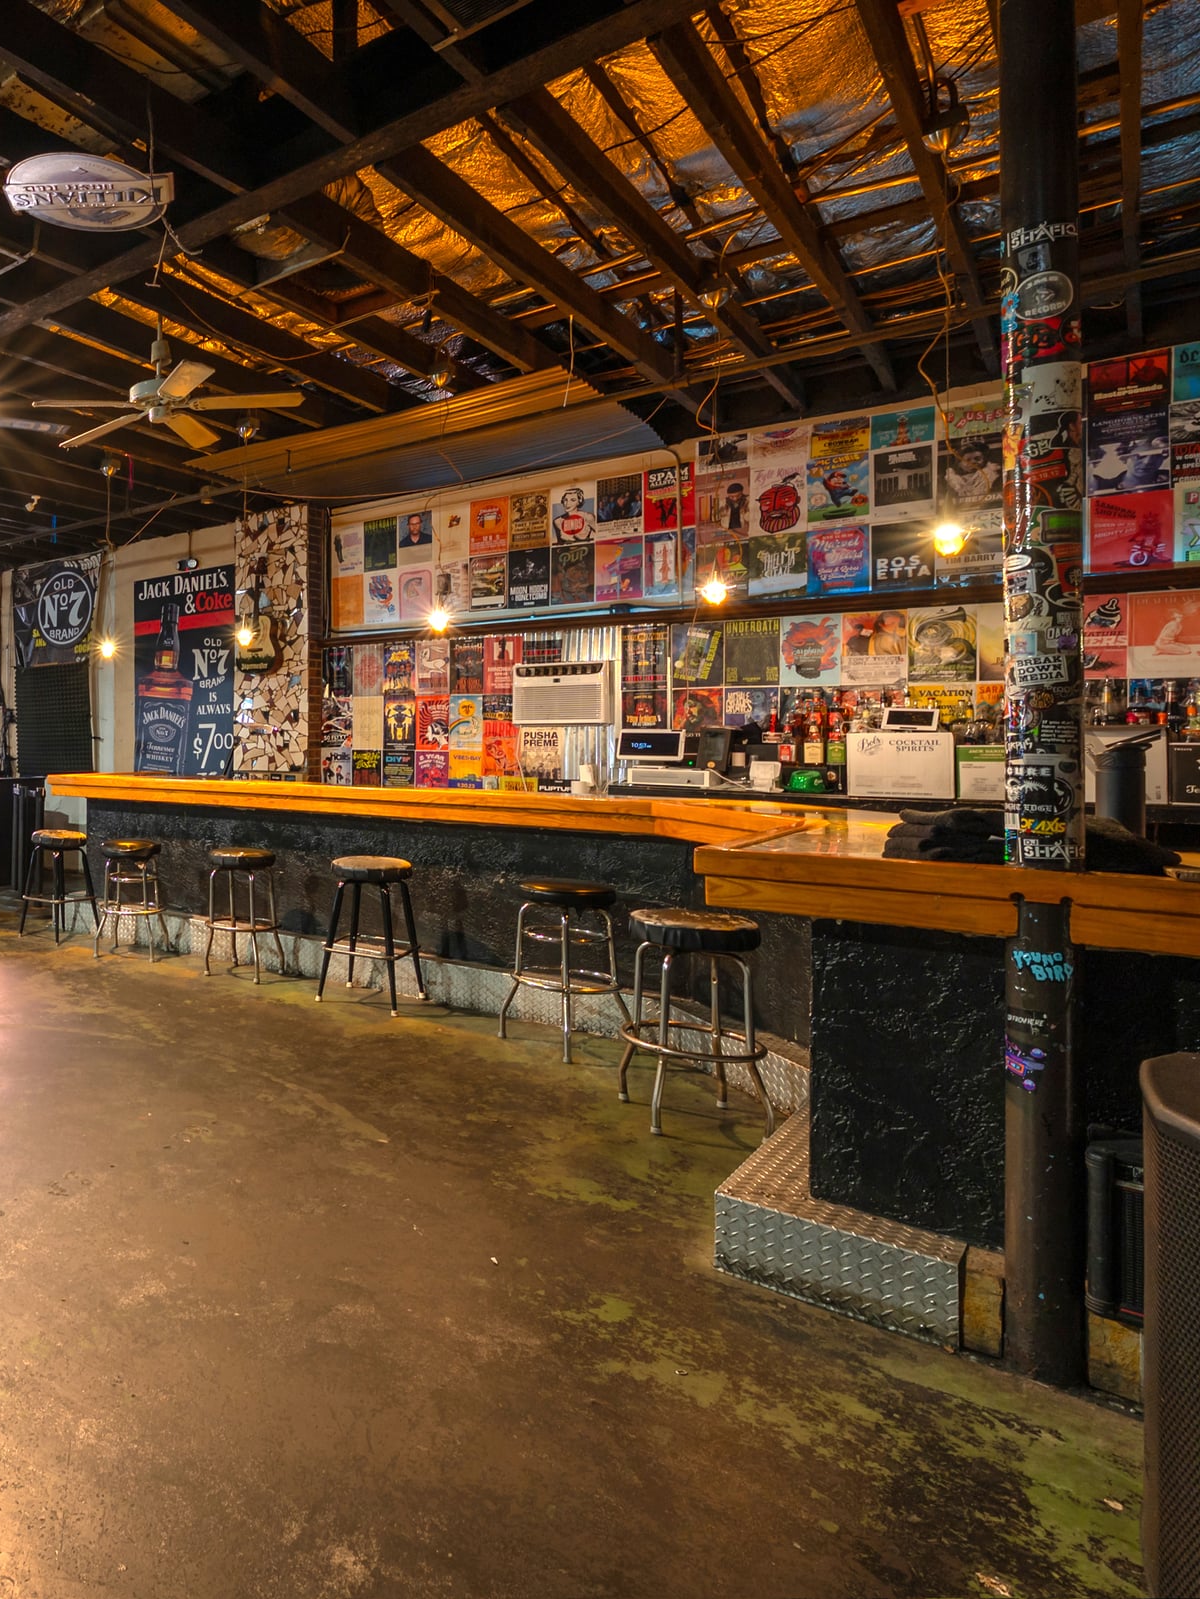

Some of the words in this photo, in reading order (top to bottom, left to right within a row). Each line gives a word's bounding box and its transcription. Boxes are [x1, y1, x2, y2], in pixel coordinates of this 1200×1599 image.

[559, 546, 589, 567] PUP
[876, 555, 921, 570] ROS
[964, 553, 996, 563] BARRY
[876, 565, 932, 581] ETTA
[53, 580, 75, 592] OLD
[138, 580, 171, 601] JACK
[174, 568, 230, 595] DANIEL'S
[196, 591, 233, 613] Coke
[726, 619, 779, 634] UNDEROATH
[49, 627, 81, 642] BRAND
[204, 638, 222, 647] OLD
[1016, 655, 1062, 668] BREAK
[1017, 663, 1063, 675] DOWN
[200, 675, 226, 690] BRAND
[1018, 671, 1064, 683] MEDIA
[209, 691, 218, 702] IS
[919, 689, 973, 697] VACATION
[196, 703, 231, 716] ALWAYS
[143, 709, 160, 724] JACK
[524, 731, 559, 740] PUSHA
[524, 739, 559, 748] PREME
[146, 754, 174, 763] WHISKEY
[1013, 950, 1064, 969] YOUNG
[1031, 963, 1074, 982] BIRD
